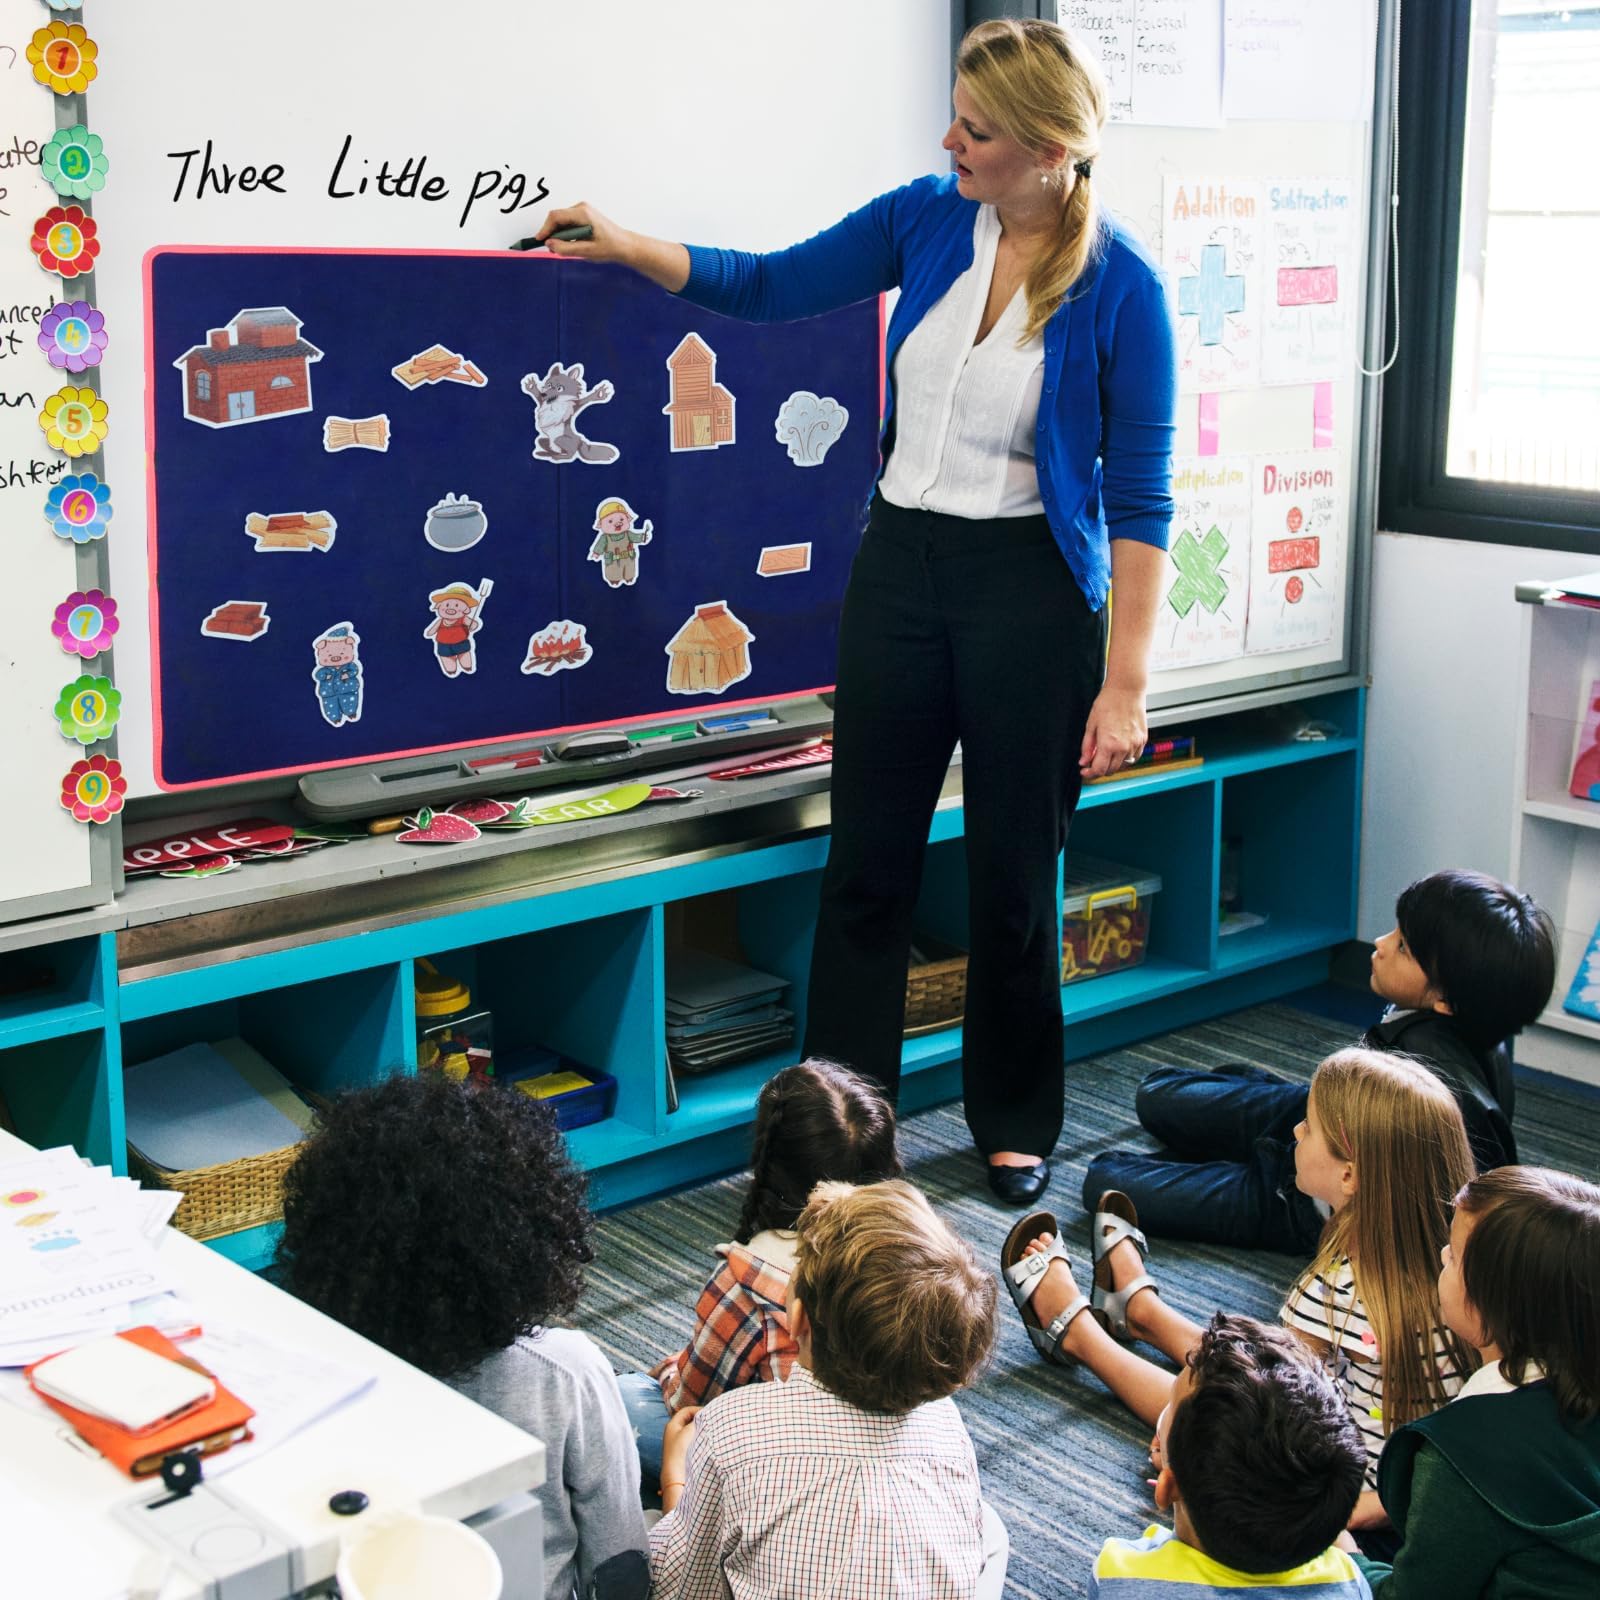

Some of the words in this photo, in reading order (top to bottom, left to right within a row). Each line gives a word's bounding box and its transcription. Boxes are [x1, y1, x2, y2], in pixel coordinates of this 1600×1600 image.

[56, 46, 70, 71] 1
[65, 150, 86, 175] 2
[167, 139, 287, 202] Three
[327, 134, 449, 202] Little
[459, 163, 550, 228] pigs
[1172, 184, 1256, 221] Addition
[1270, 187, 1348, 212] Subtraction
[57, 226, 75, 254] 3
[64, 322, 83, 348] 4
[67, 408, 83, 434] 5
[1264, 464, 1333, 495] Division
[69, 493, 88, 523] 6
[76, 610, 95, 638] 7
[80, 694, 97, 722] 8
[85, 774, 103, 803] 9
[526, 799, 617, 823] EAR
